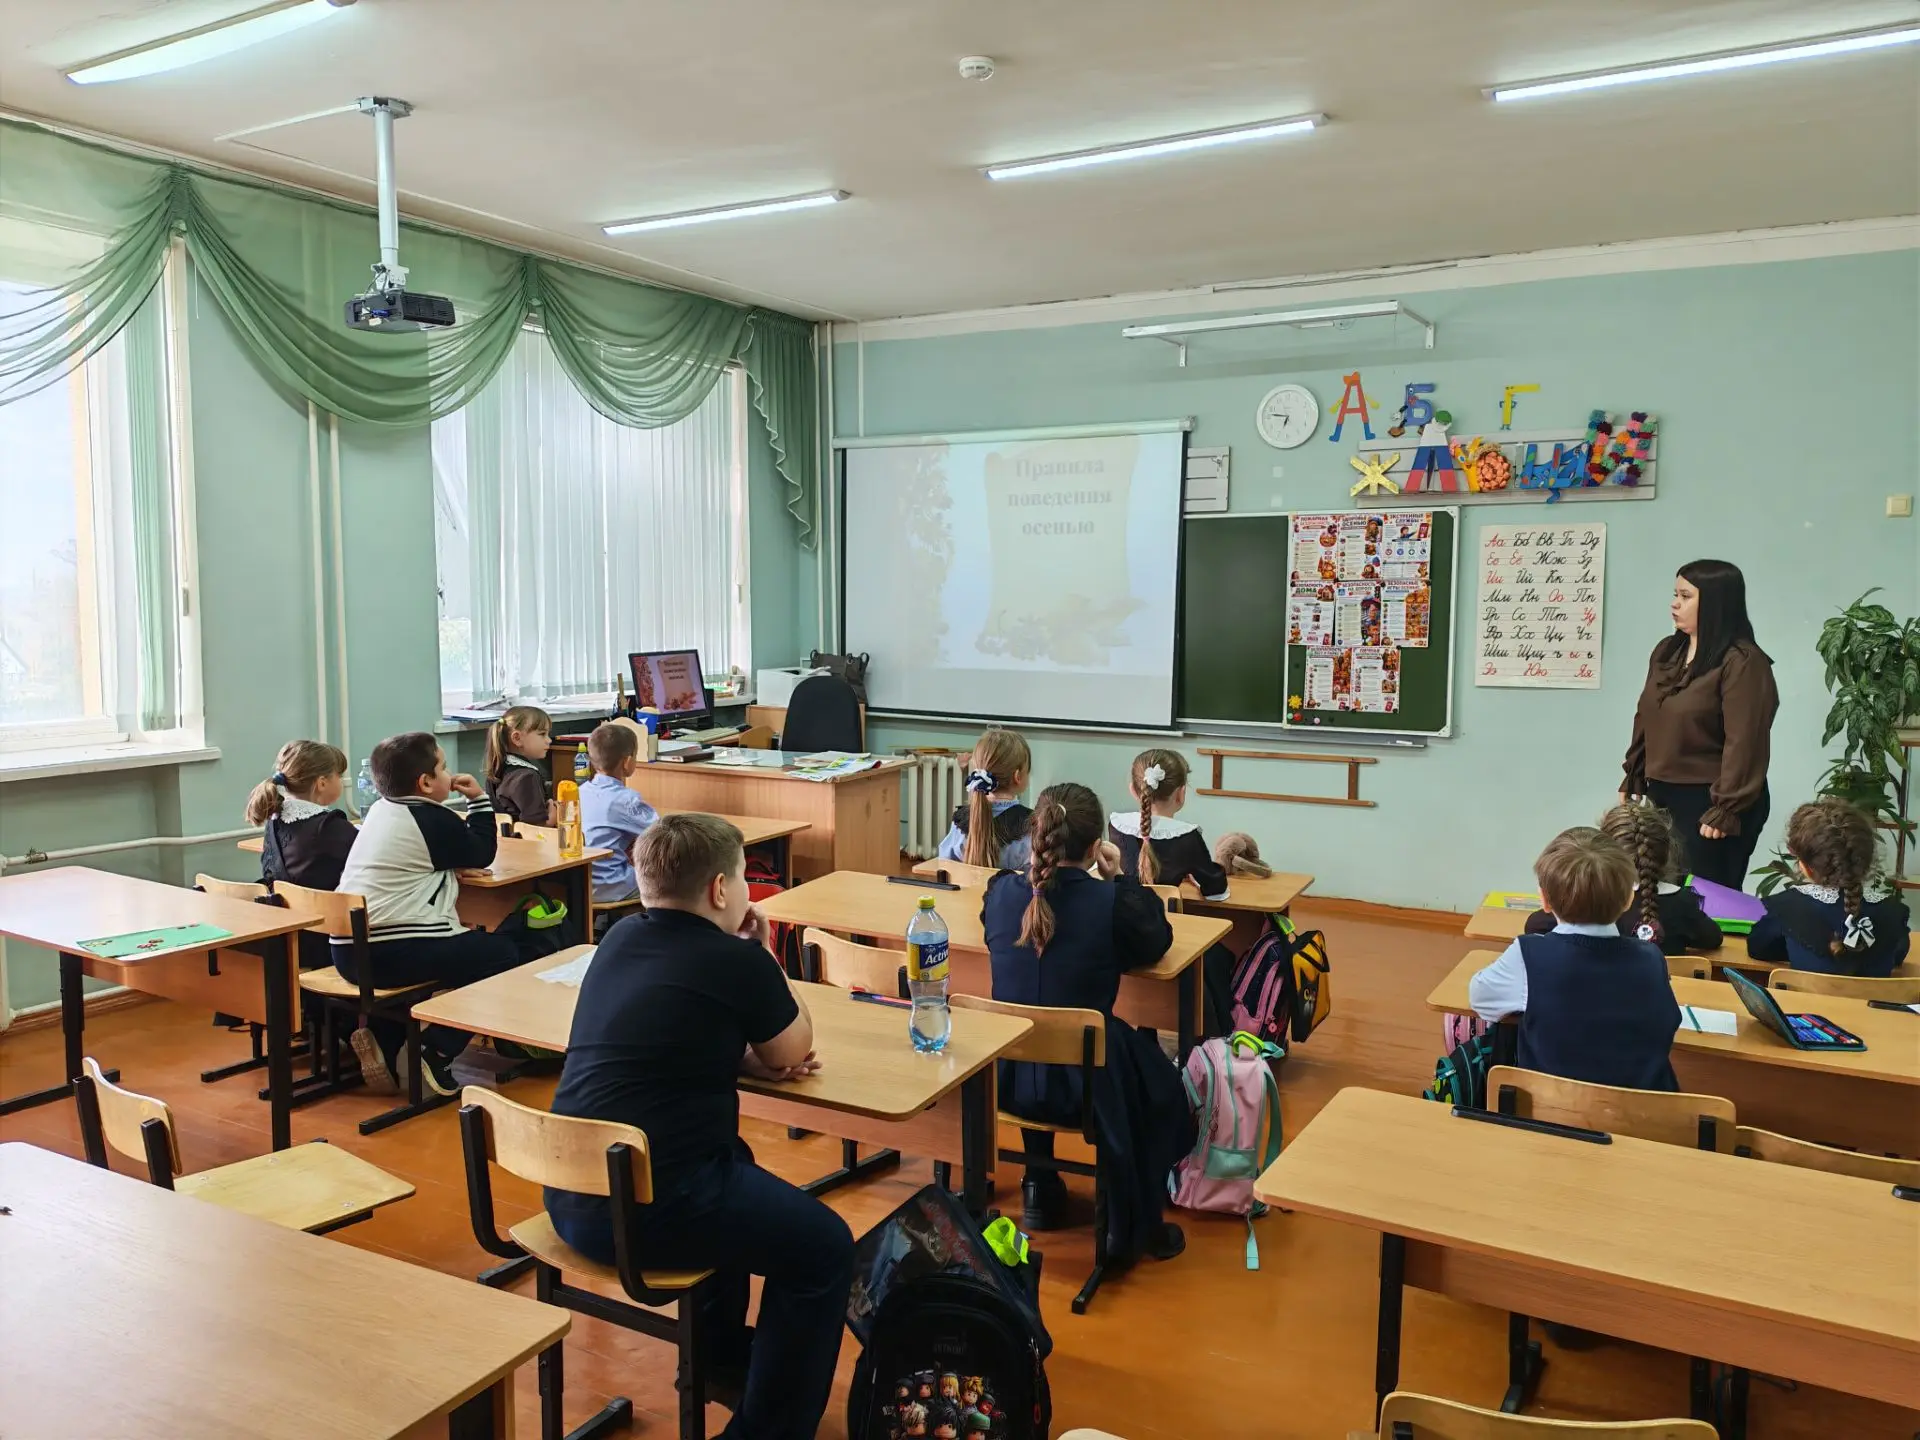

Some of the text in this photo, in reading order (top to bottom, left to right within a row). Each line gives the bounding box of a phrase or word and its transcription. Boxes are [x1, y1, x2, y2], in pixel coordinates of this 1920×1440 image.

[1016, 458, 1105, 481] Правила
[1007, 490, 1112, 508] поведения
[1022, 520, 1095, 536] осенью
[1485, 533, 1506, 547] Аа
[1513, 532, 1536, 547] Бб
[1536, 532, 1554, 547] Вв
[1560, 531, 1575, 546] Гг
[1533, 551, 1567, 565] Жж
[1483, 589, 1512, 602] Мм
[1519, 588, 1540, 602] Нн
[1573, 588, 1596, 602] Пп
[1482, 607, 1500, 625] Рр
[1512, 607, 1526, 621] Сс
[1510, 625, 1536, 640] Хх
[1484, 644, 1509, 657] Шш
[1517, 643, 1546, 661] Щщ
